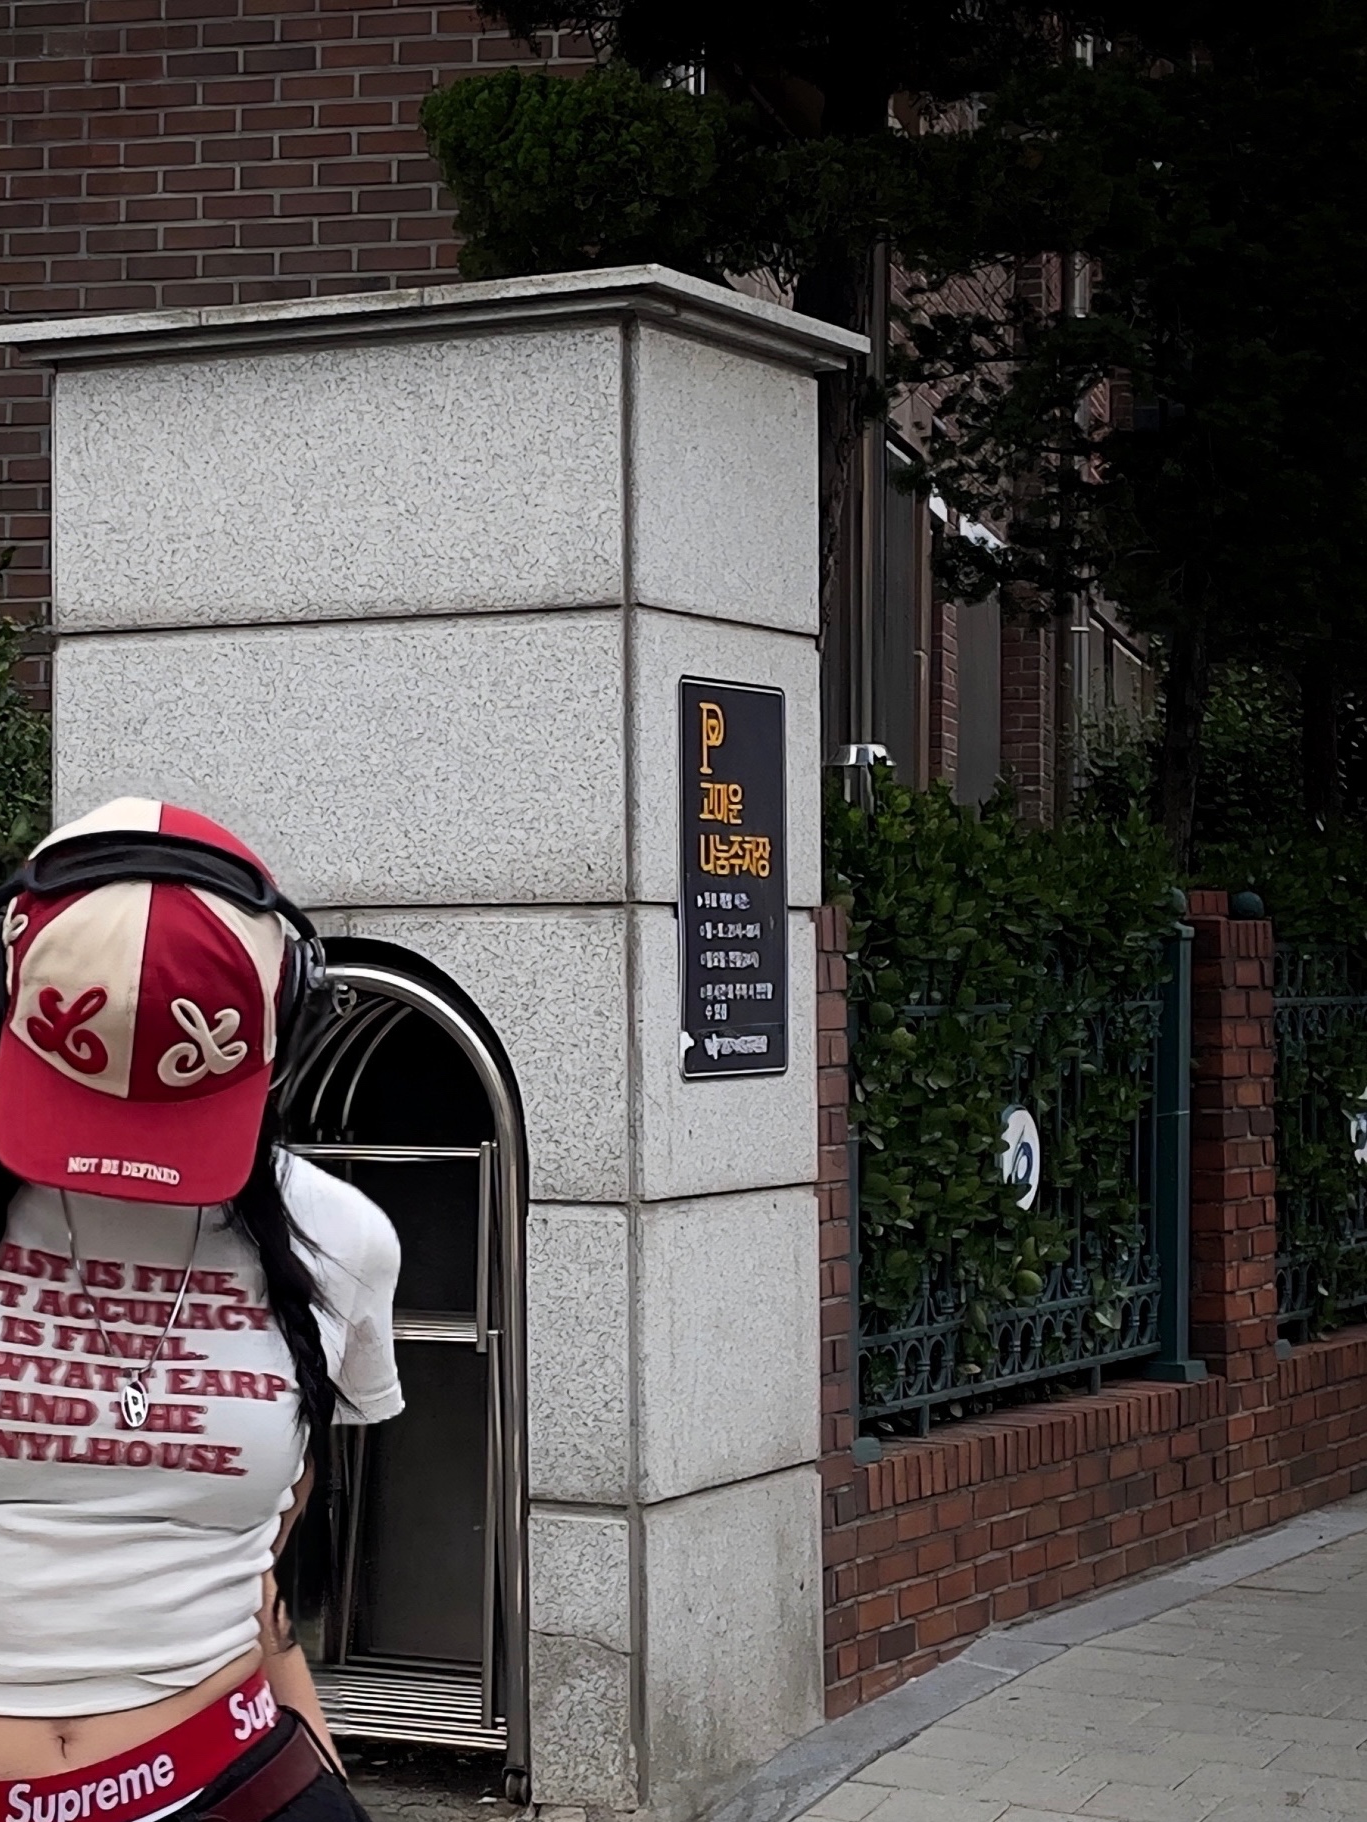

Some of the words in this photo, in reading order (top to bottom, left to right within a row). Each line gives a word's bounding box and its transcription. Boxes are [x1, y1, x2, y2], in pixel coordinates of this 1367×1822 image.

[699, 782, 743, 824] 고마운
[699, 834, 770, 877] 나눔주차장
[67, 1156, 99, 1173] NOT
[100, 1158, 120, 1175] BE
[121, 1160, 180, 1185] DEFINED
[83, 1260, 125, 1289] IS
[33, 1290, 270, 1331] ACCURACY
[0, 1315, 46, 1347] IS
[165, 1368, 289, 1401] EARP
